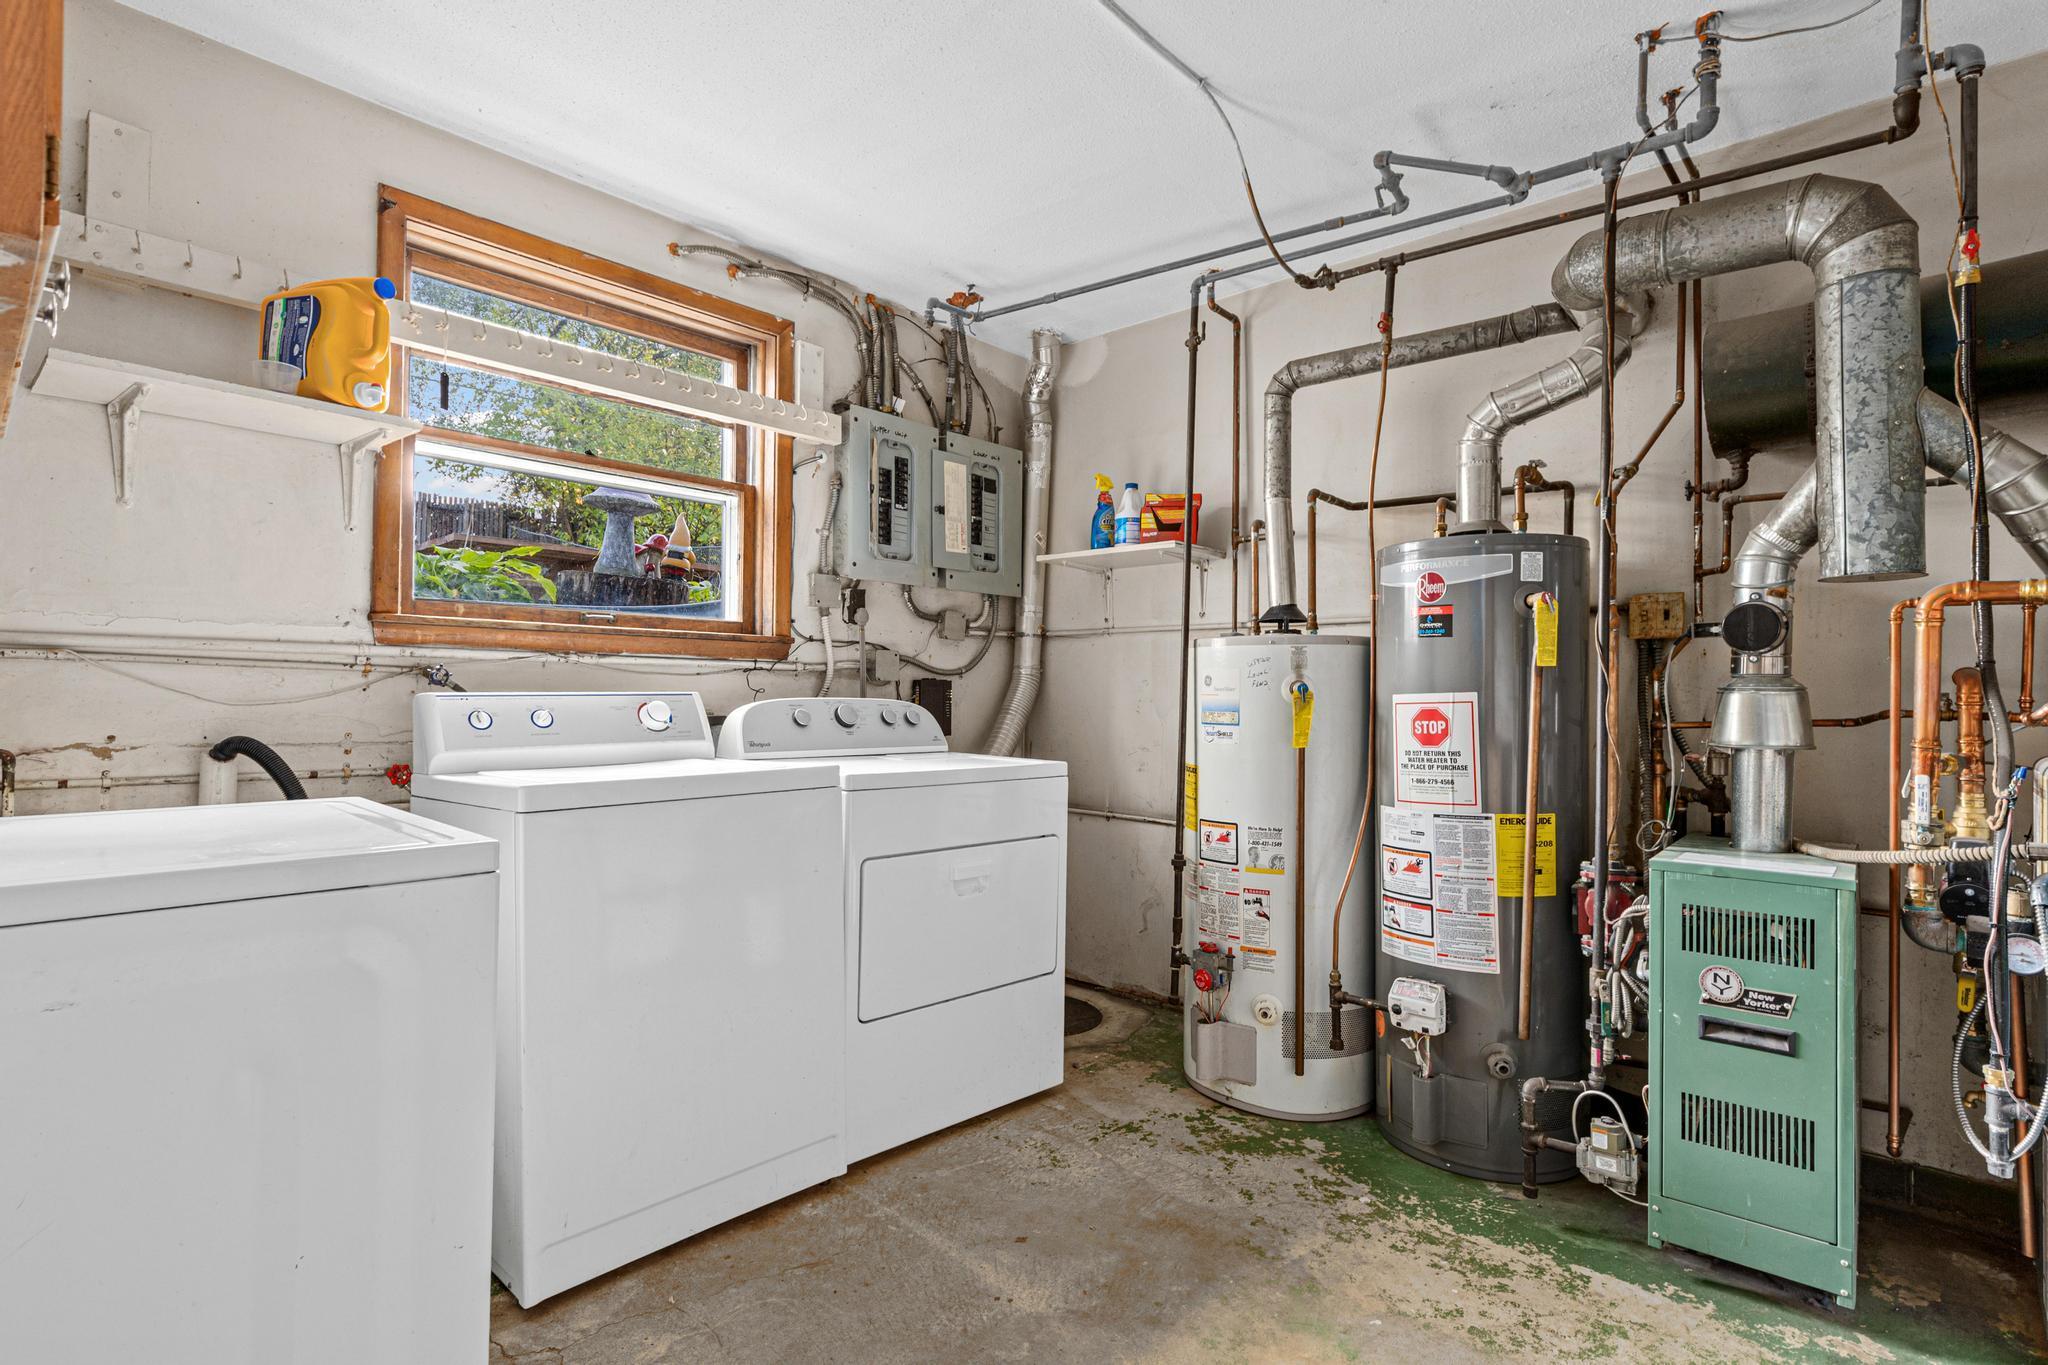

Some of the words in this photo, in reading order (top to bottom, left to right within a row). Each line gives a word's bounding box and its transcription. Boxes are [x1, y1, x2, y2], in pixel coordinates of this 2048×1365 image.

[1401, 559, 1471, 573] PERFORMANCE
[1418, 573, 1444, 598] Rheem
[1414, 720, 1446, 734] STOP
[1500, 817, 1552, 825] ENERGUIDE
[1713, 972, 1730, 985] N
[1711, 983, 1733, 995] Y
[1748, 991, 1775, 1002] New
[1743, 998, 1781, 1011] Yorker
